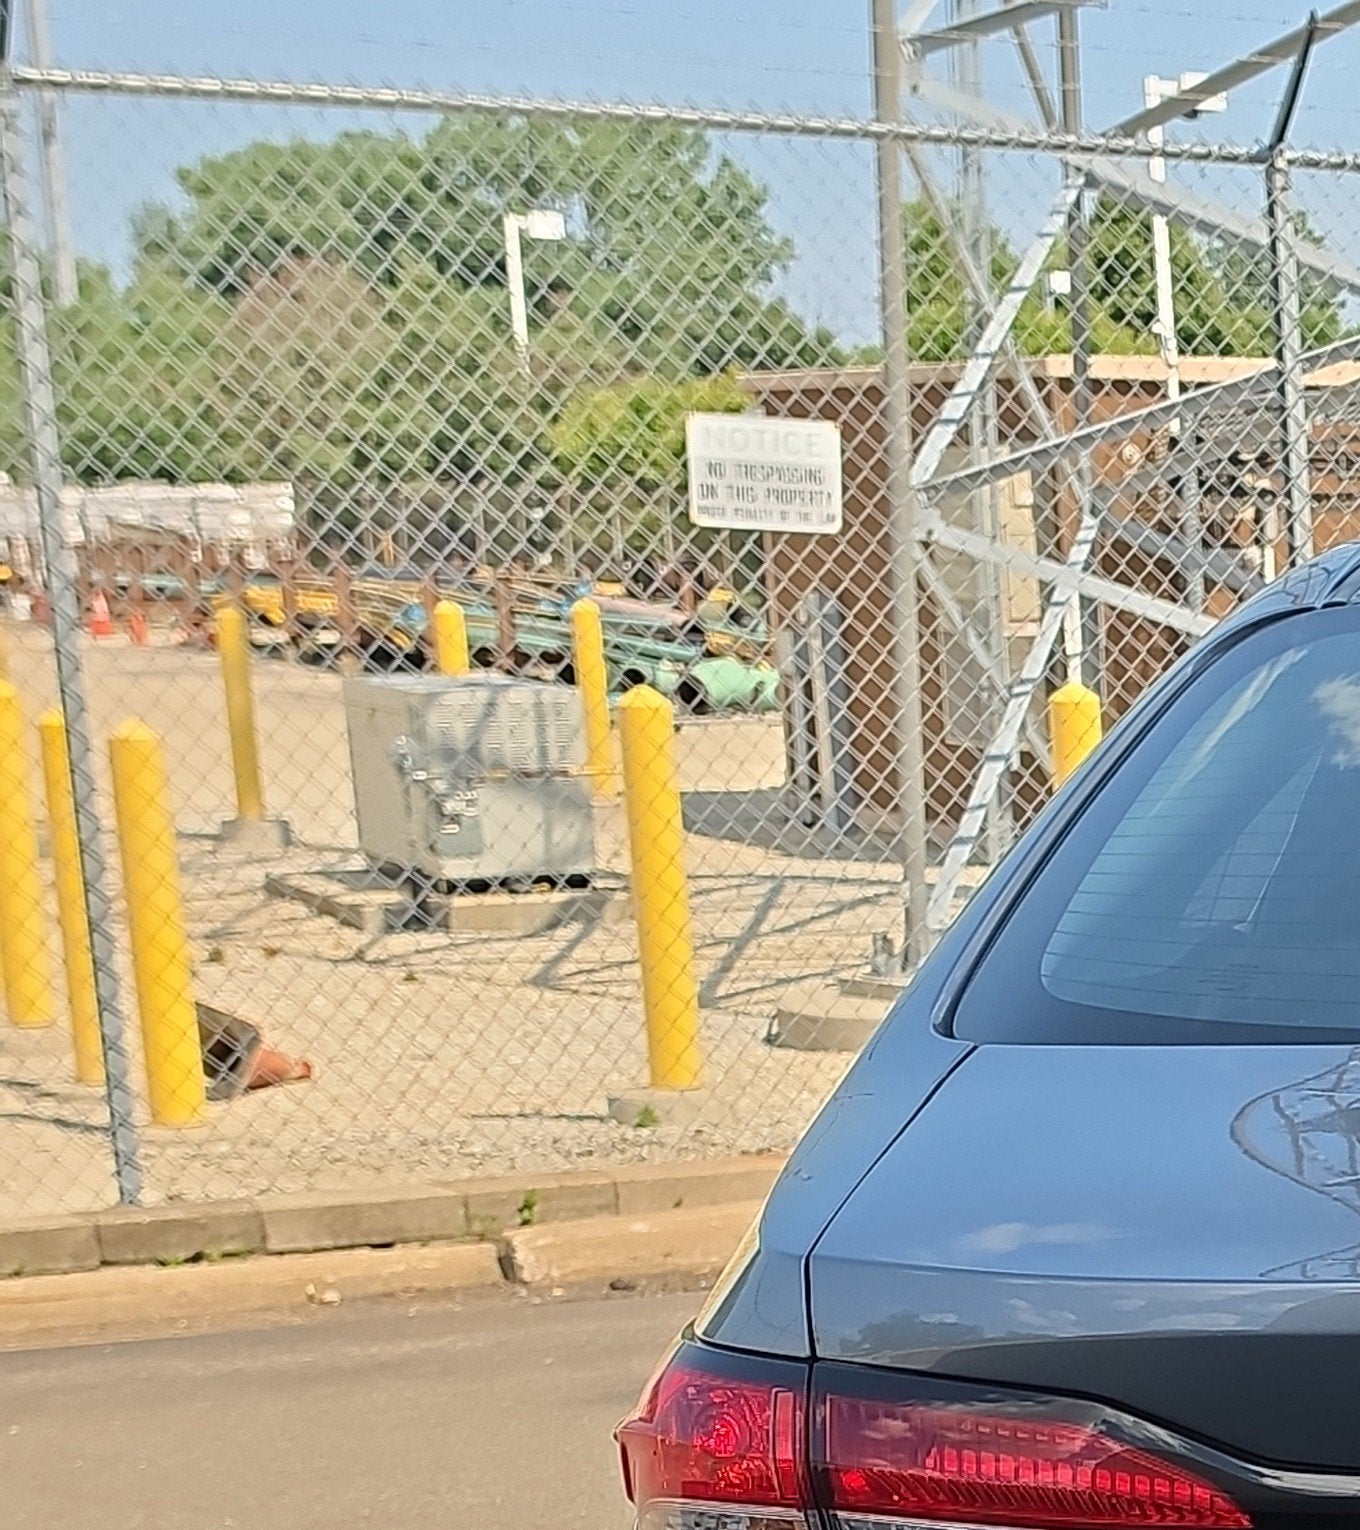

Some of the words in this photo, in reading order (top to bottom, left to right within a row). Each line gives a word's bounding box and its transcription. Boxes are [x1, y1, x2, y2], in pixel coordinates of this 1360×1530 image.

[704, 425, 825, 457] NOTICE
[707, 460, 727, 480] NO
[699, 483, 719, 501] ON
